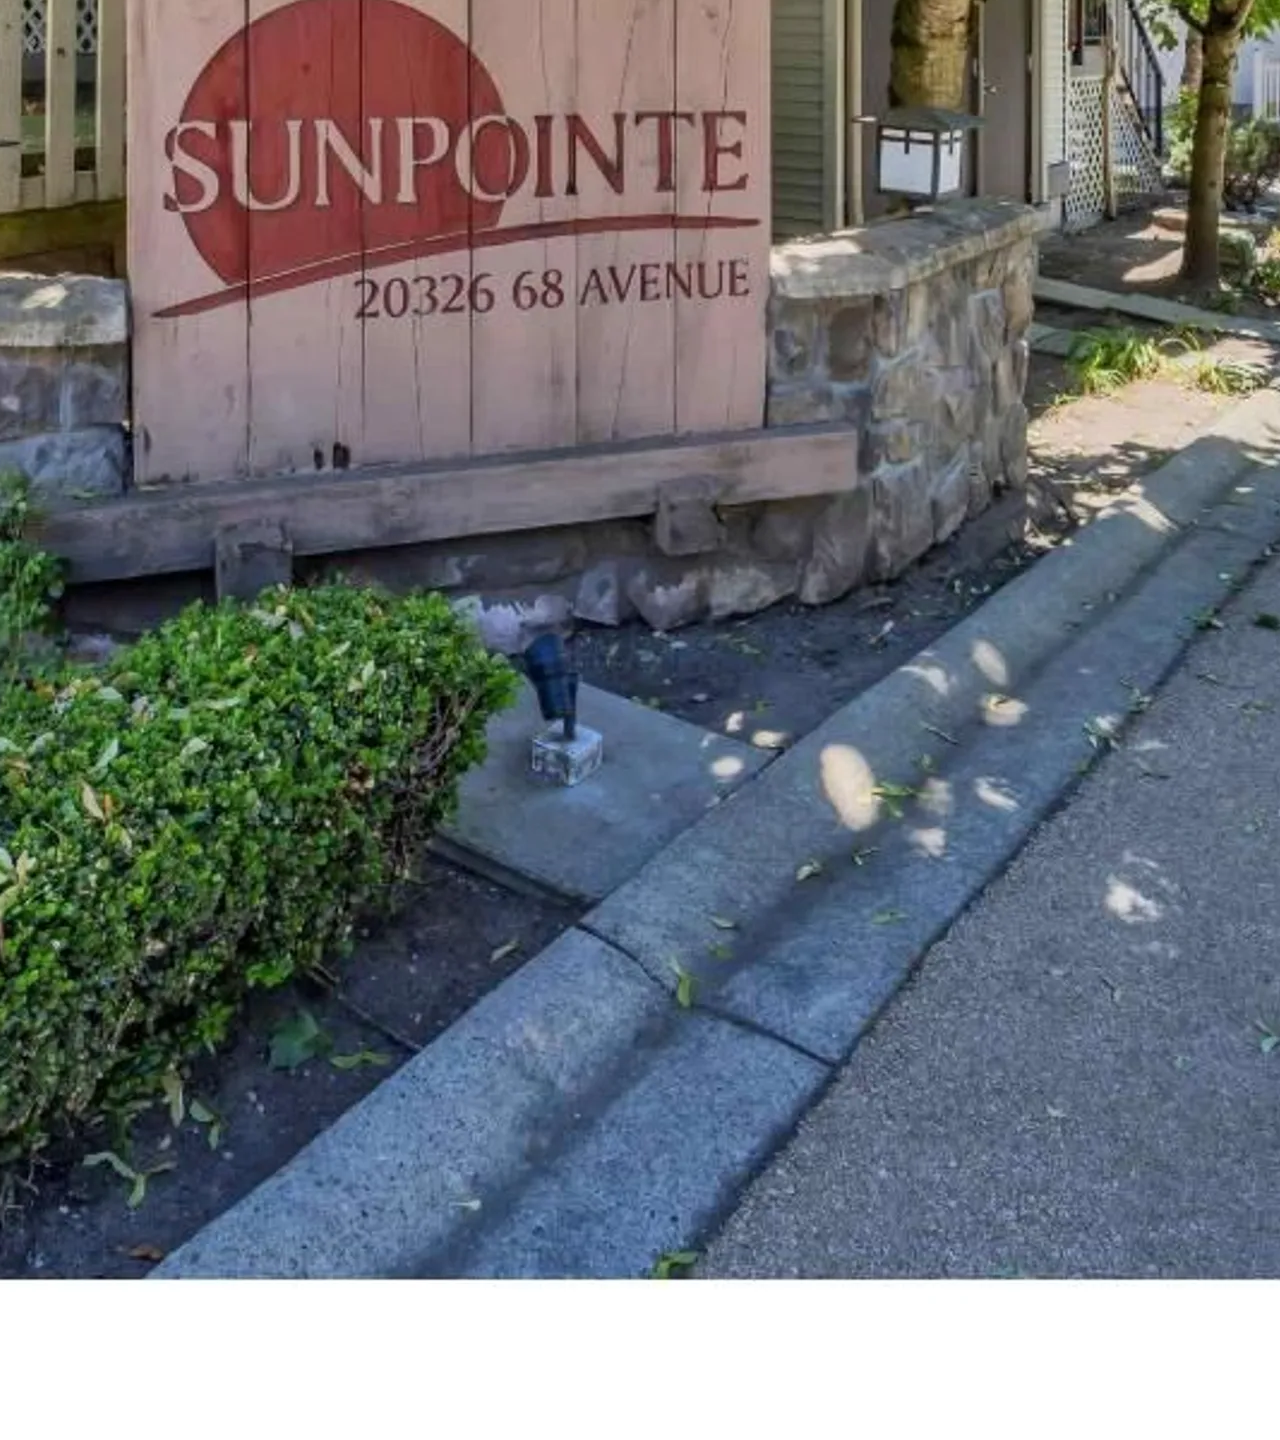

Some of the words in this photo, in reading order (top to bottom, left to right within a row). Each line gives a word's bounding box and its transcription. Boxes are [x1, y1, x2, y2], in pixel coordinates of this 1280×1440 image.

[163, 110, 749, 213] SUNPOINTE
[354, 273, 496, 320] 20326
[512, 268, 565, 311] 68
[580, 260, 751, 306] AVENUE
